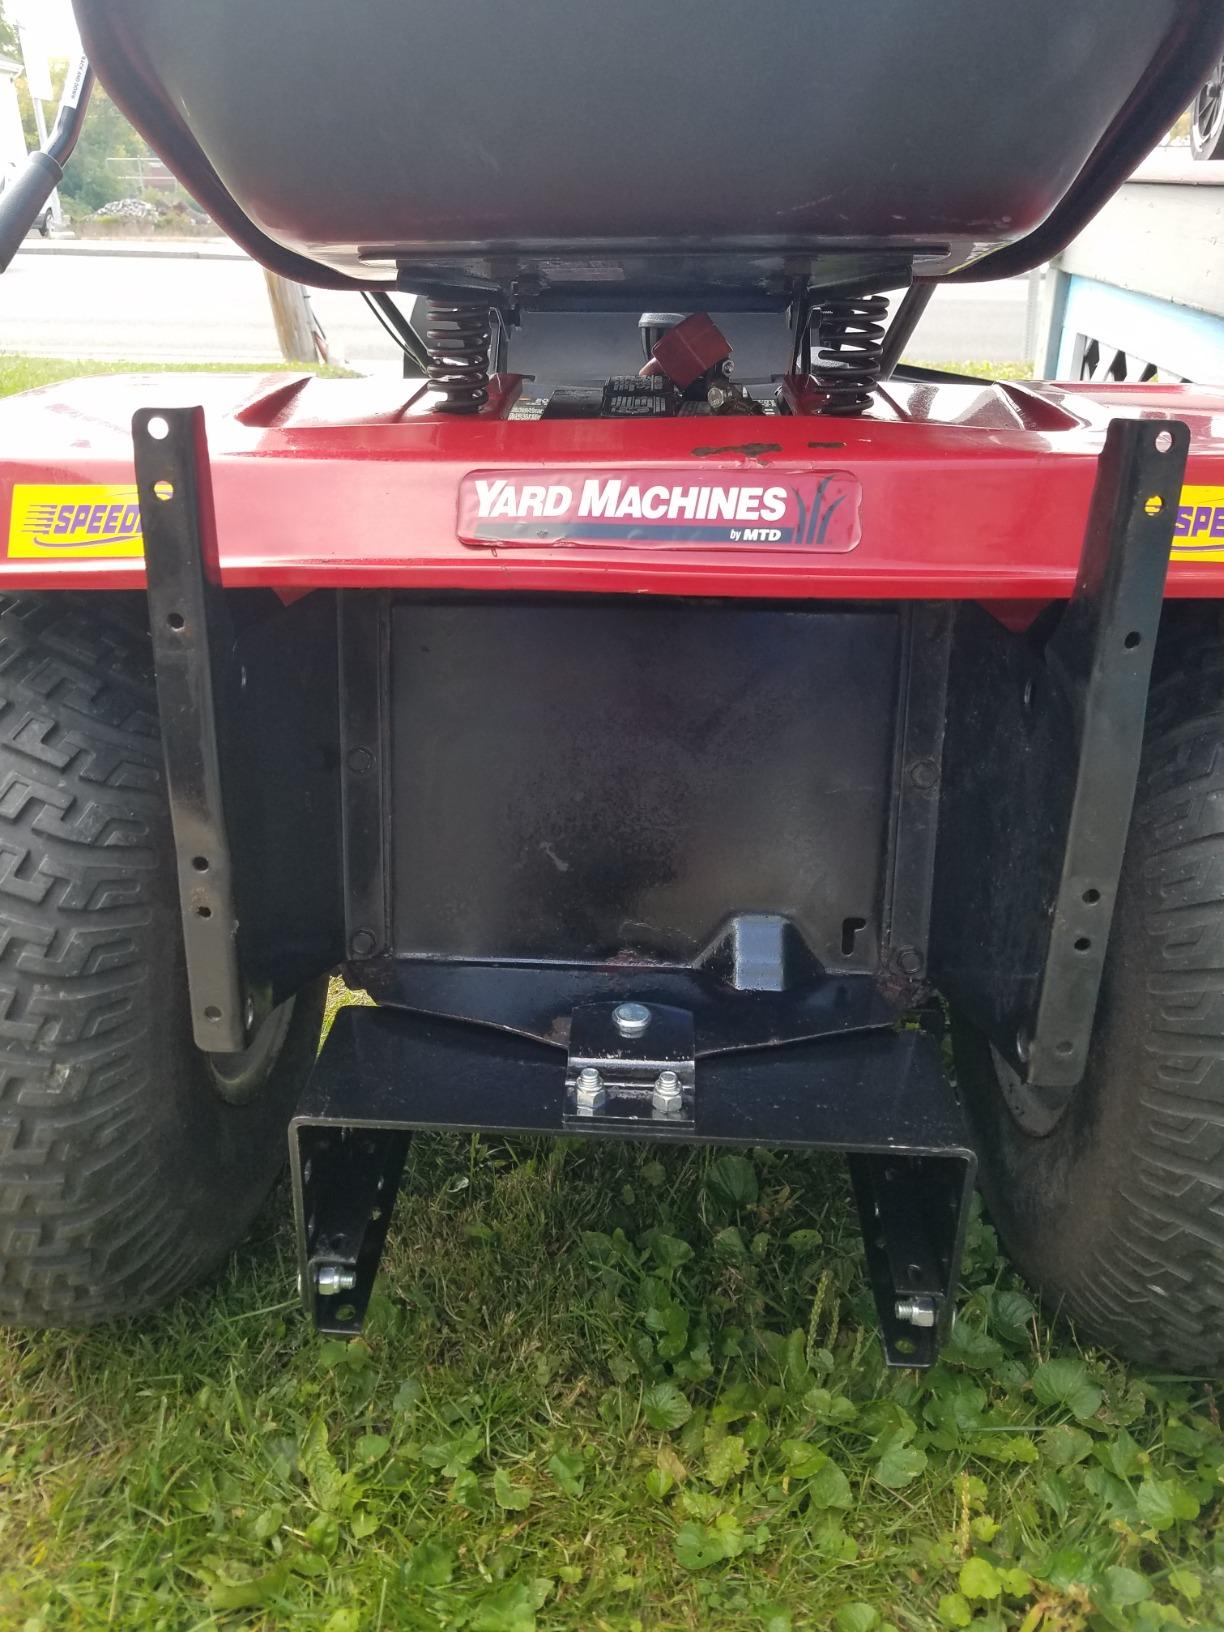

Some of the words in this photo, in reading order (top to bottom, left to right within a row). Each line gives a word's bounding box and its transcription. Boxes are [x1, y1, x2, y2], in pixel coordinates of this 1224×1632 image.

[475, 479, 573, 518] YARD
[577, 479, 788, 521] MACHINES
[730, 529, 741, 541] by
[743, 529, 782, 541] MTD
